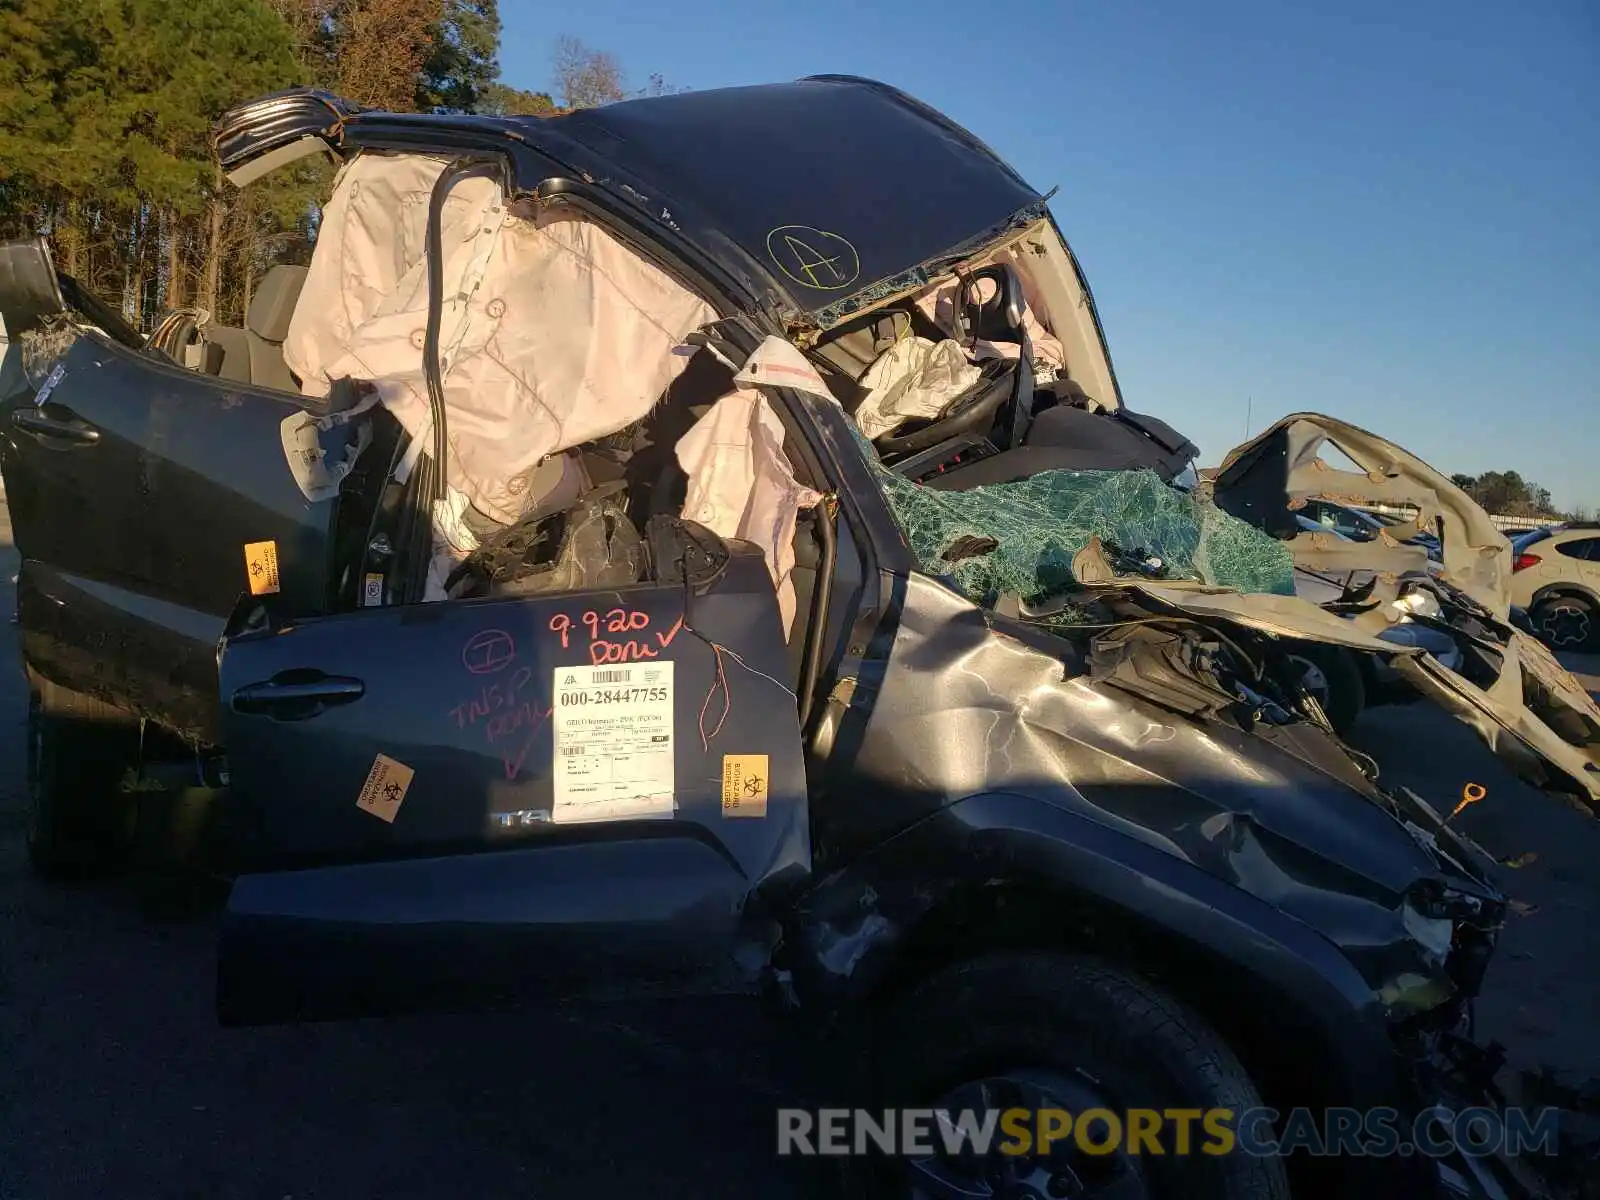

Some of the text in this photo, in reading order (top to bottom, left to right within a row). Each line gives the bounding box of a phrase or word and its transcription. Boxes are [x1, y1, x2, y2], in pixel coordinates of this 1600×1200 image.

[784, 235, 841, 288] A
[561, 687, 668, 706] 000-28447755
[733, 763, 741, 808] BIOHAZARD
